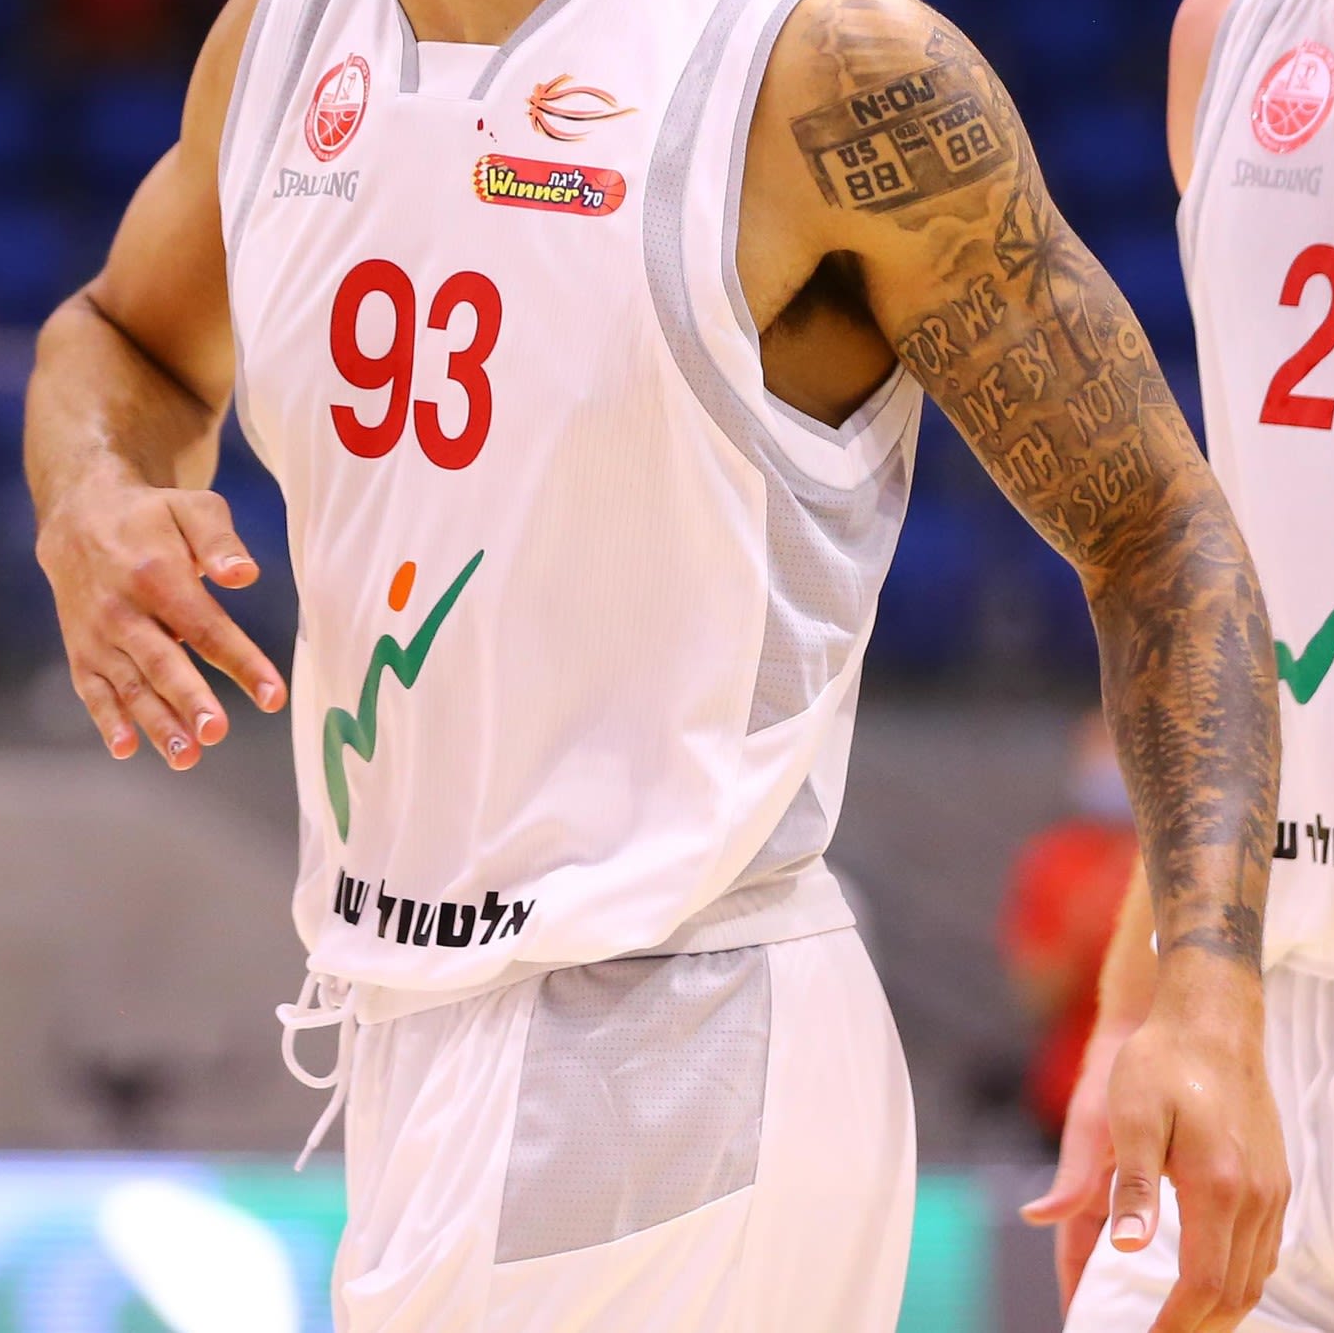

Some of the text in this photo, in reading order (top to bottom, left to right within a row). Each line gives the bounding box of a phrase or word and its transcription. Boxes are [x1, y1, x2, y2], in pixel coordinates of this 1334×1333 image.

[837, 138, 878, 168] US
[947, 123, 994, 166] 88
[487, 167, 580, 204] Winner
[547, 169, 584, 188] ליגת
[583, 186, 604, 208] סל
[845, 162, 904, 201] 88
[1231, 158, 1323, 197] SPALDING
[951, 274, 1007, 343] WE
[330, 259, 502, 470] 93
[1005, 329, 1058, 400] BY
[1065, 361, 1126, 448] NOT
[1071, 434, 1153, 527] SIGHT
